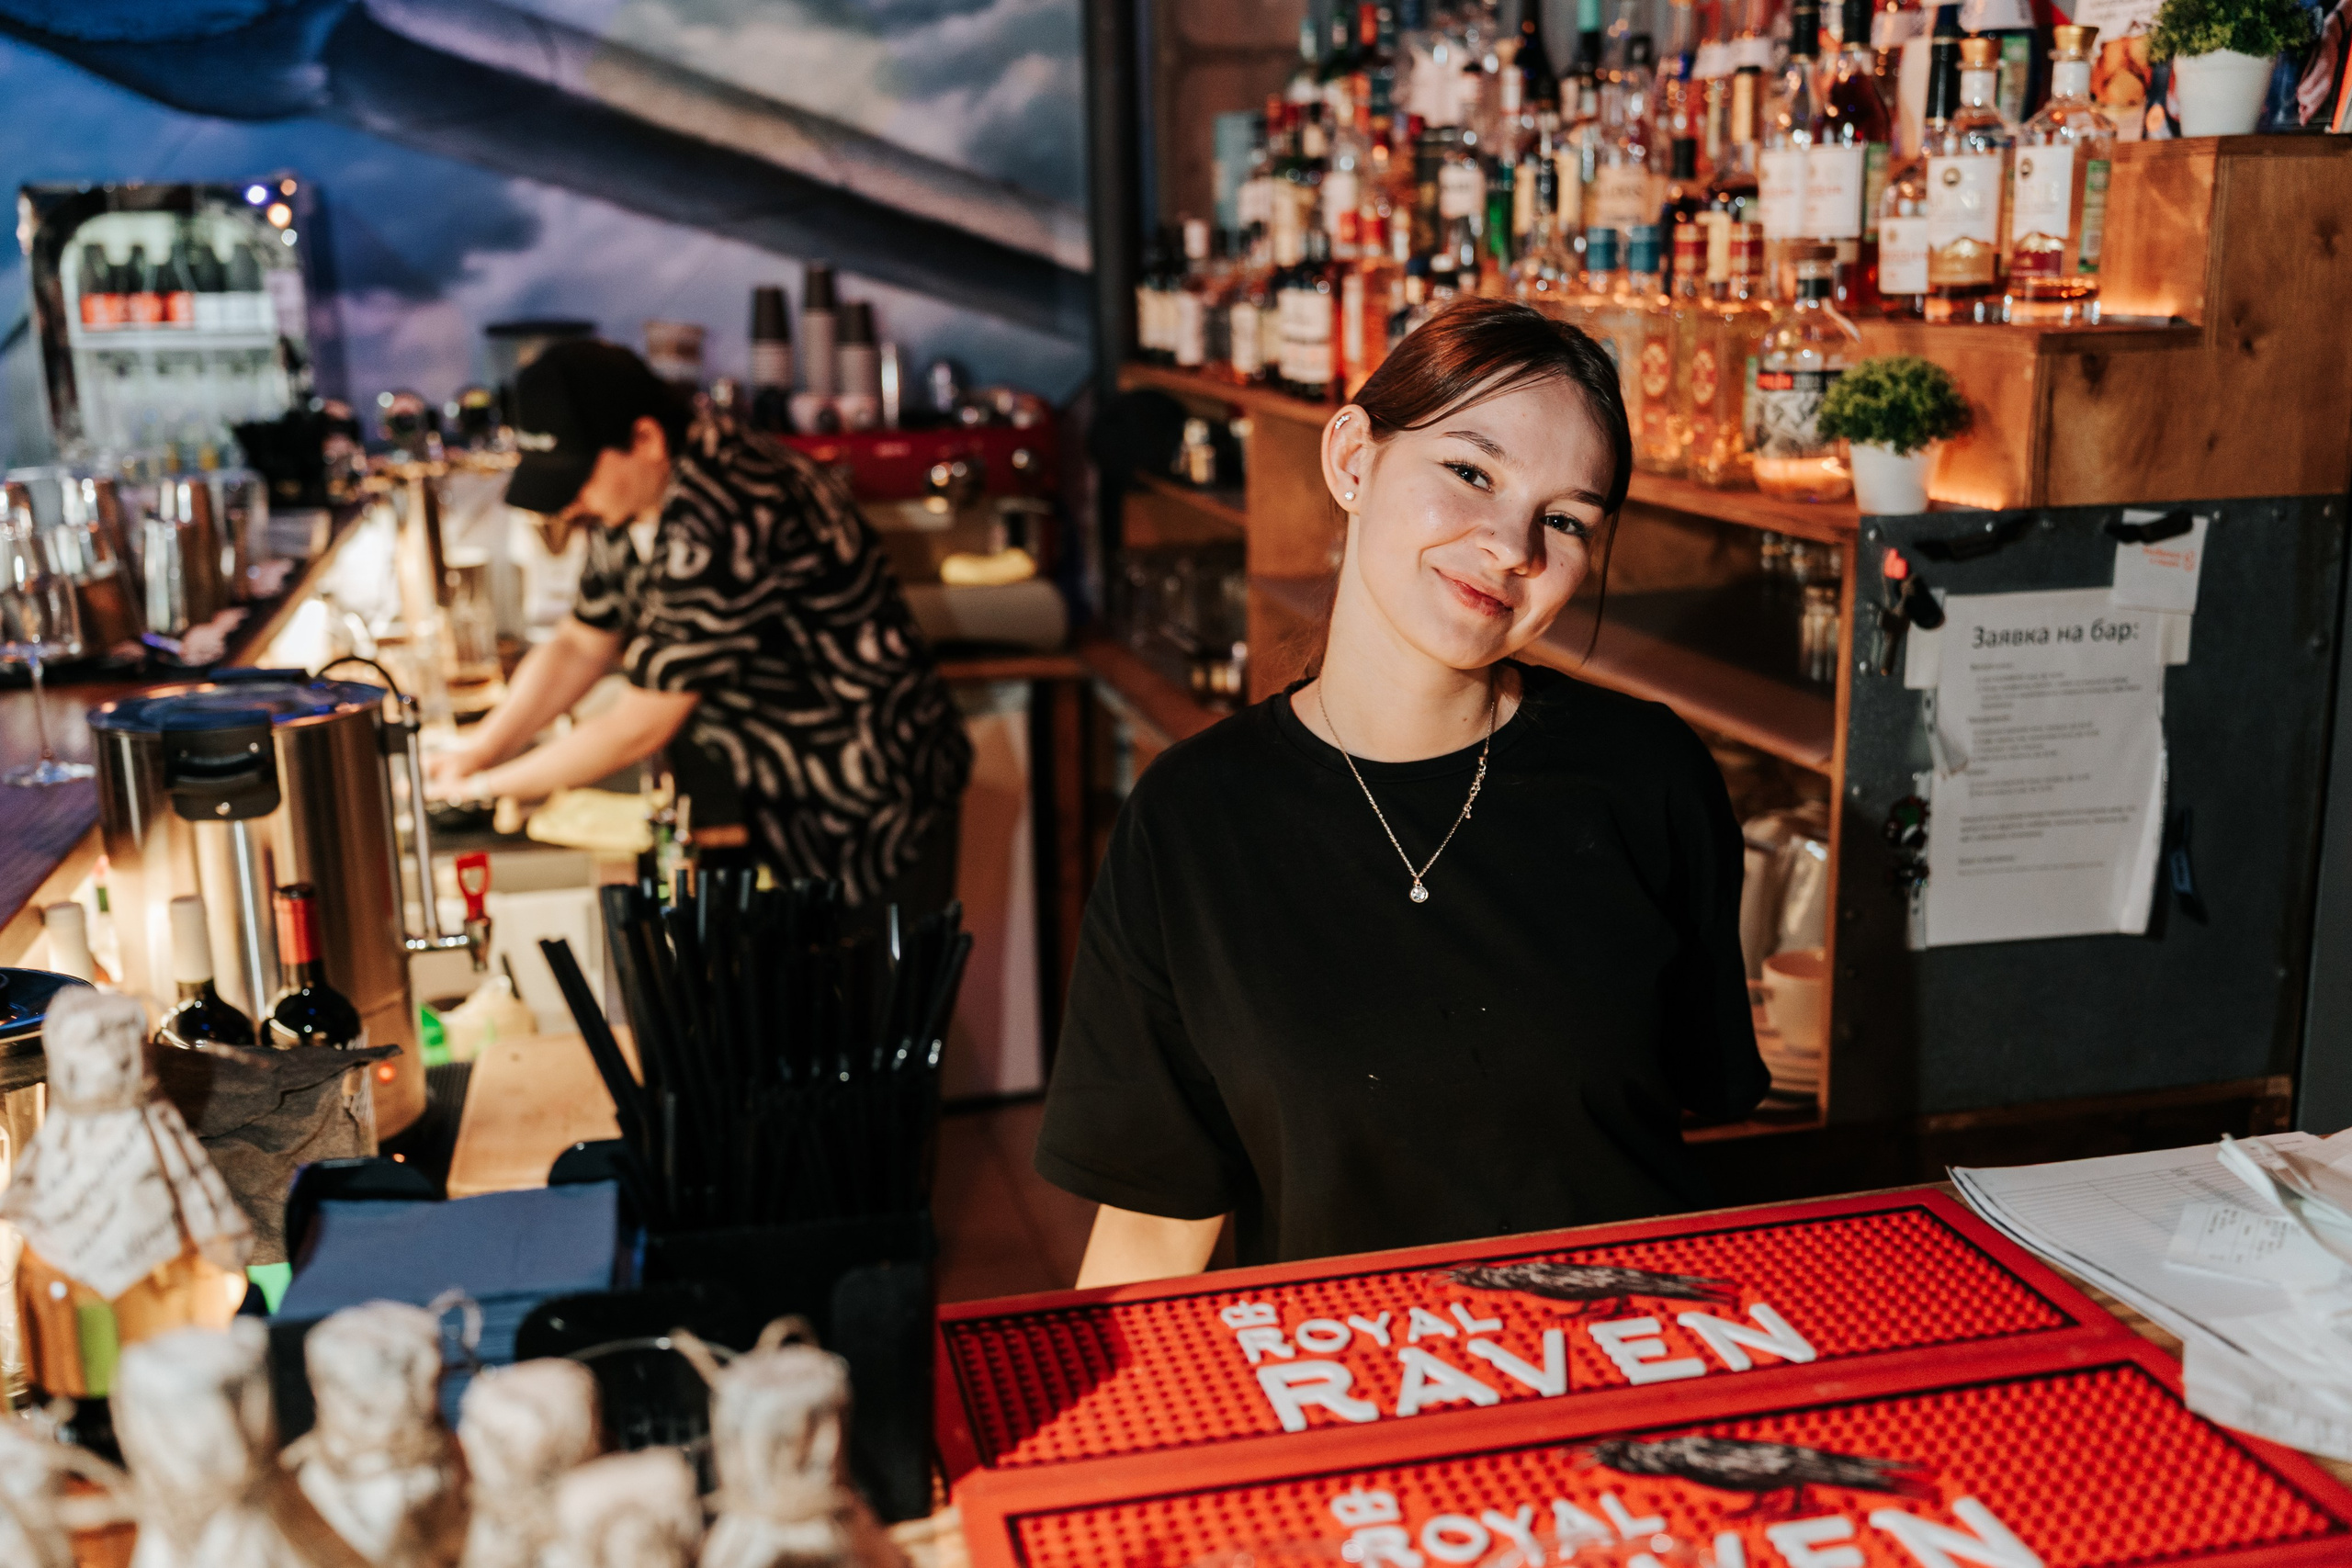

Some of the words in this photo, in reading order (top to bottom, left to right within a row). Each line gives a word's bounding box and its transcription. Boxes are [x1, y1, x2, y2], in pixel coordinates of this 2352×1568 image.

[1972, 625, 2050, 649] Заявка
[2057, 624, 2085, 644] на
[2090, 617, 2140, 645] бар:
[1236, 1302, 1504, 1363] ROYAL
[1256, 1303, 1817, 1432] RAVEN
[1351, 1492, 1666, 1568] ROYAL
